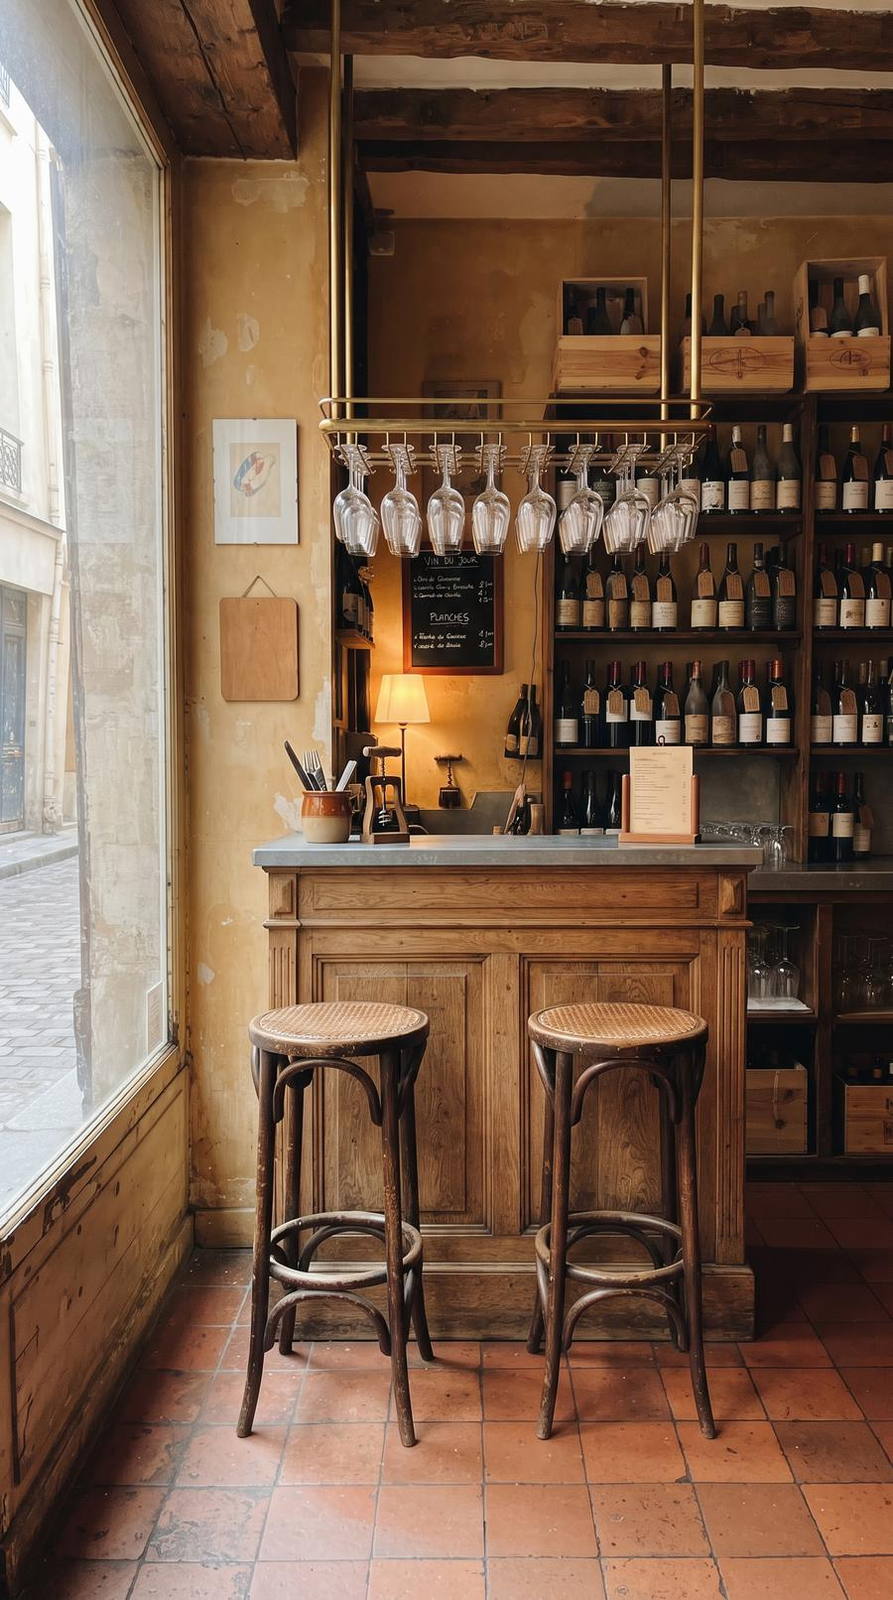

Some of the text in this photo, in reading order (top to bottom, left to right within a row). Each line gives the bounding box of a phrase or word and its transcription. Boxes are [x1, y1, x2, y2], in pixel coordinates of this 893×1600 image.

[424, 556, 478, 566] VIN DU JOUR
[429, 612, 470, 622] PLANCHES
